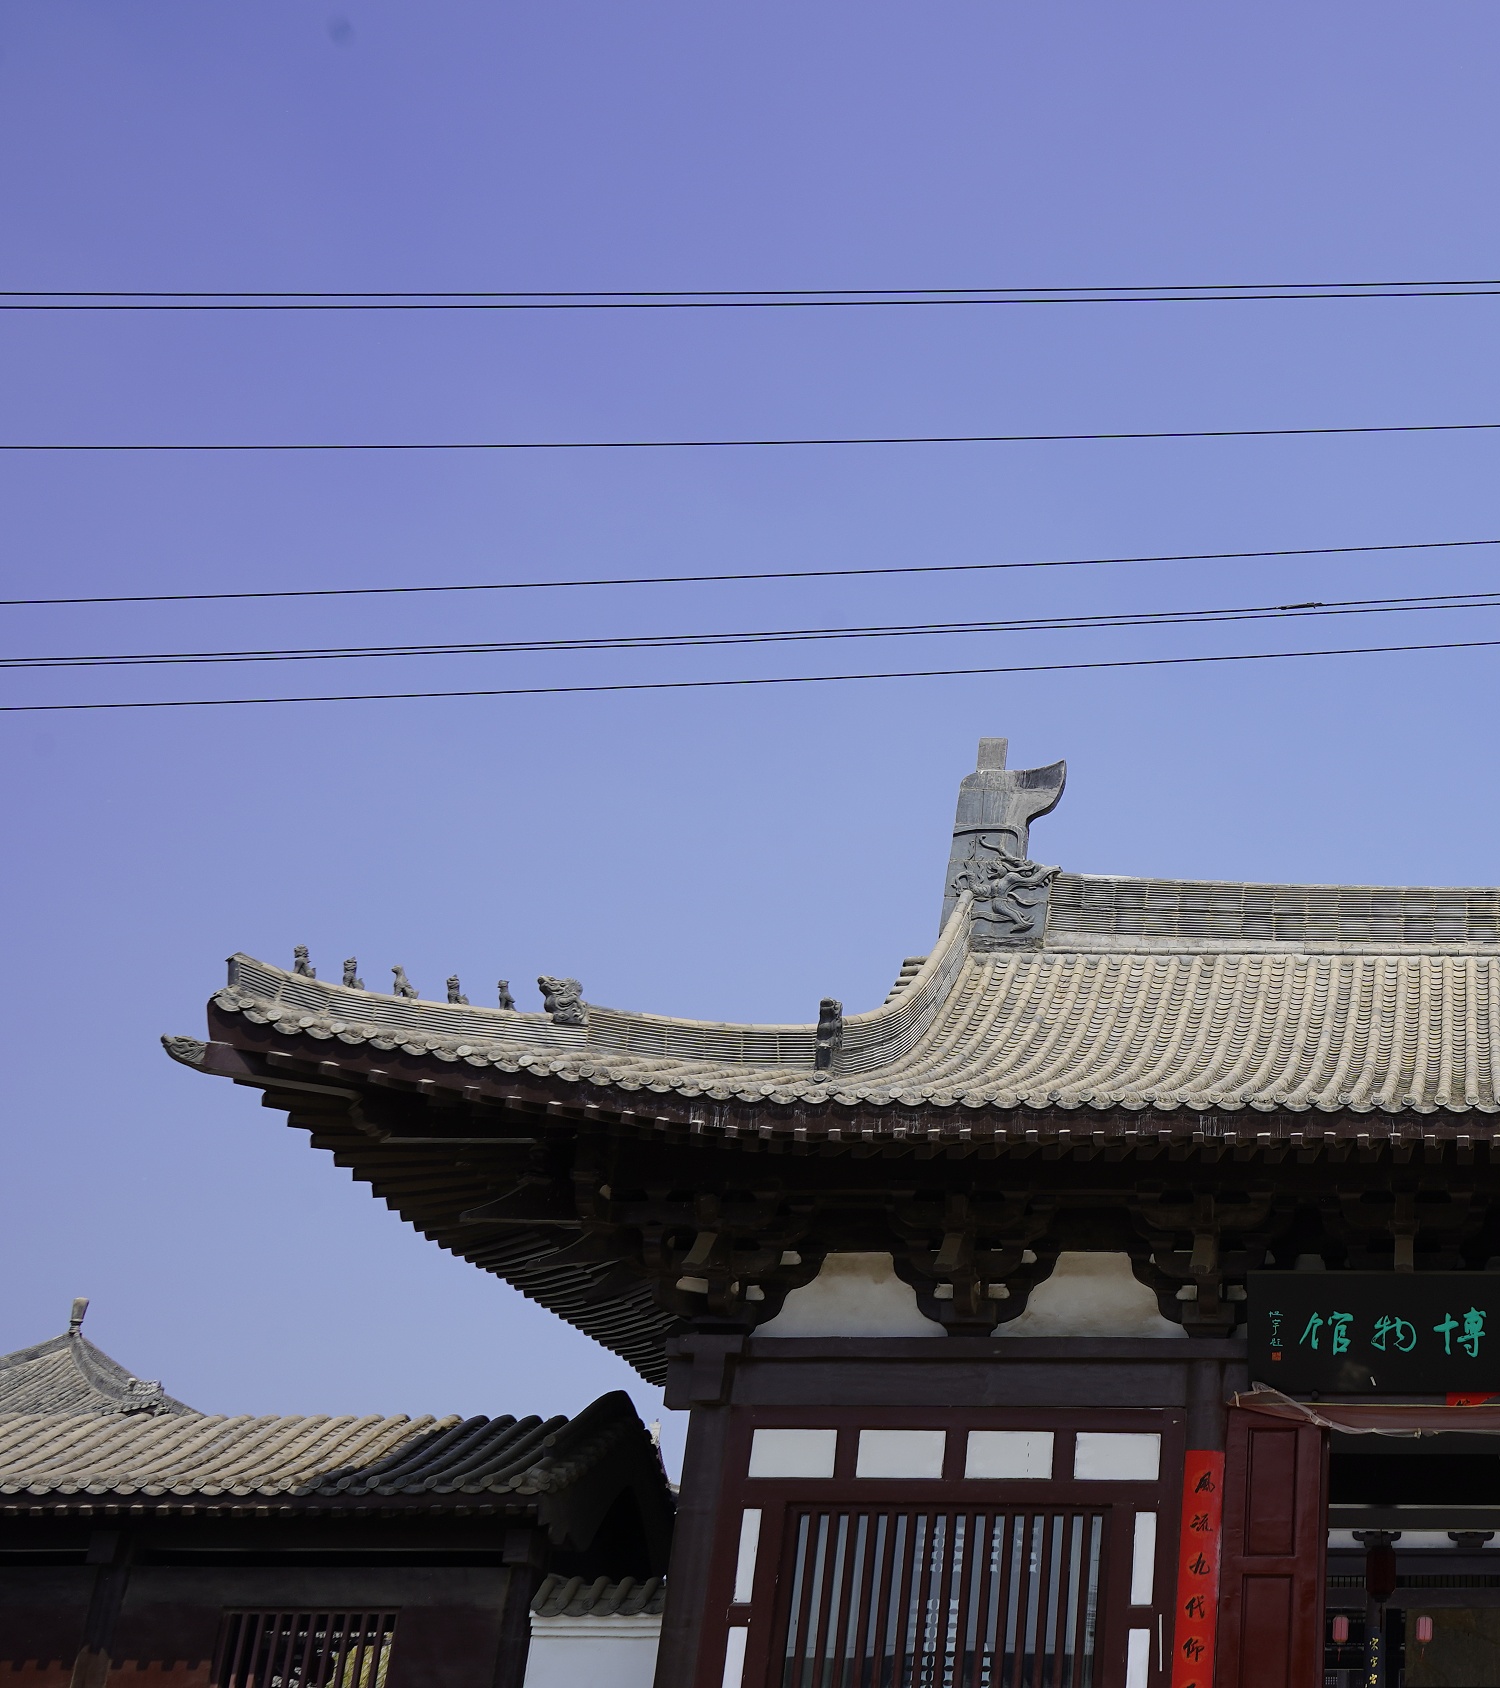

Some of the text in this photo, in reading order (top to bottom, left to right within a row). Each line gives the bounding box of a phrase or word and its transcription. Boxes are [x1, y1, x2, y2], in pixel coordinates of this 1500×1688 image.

[1182, 1471, 1216, 1688] 風流九代仰
